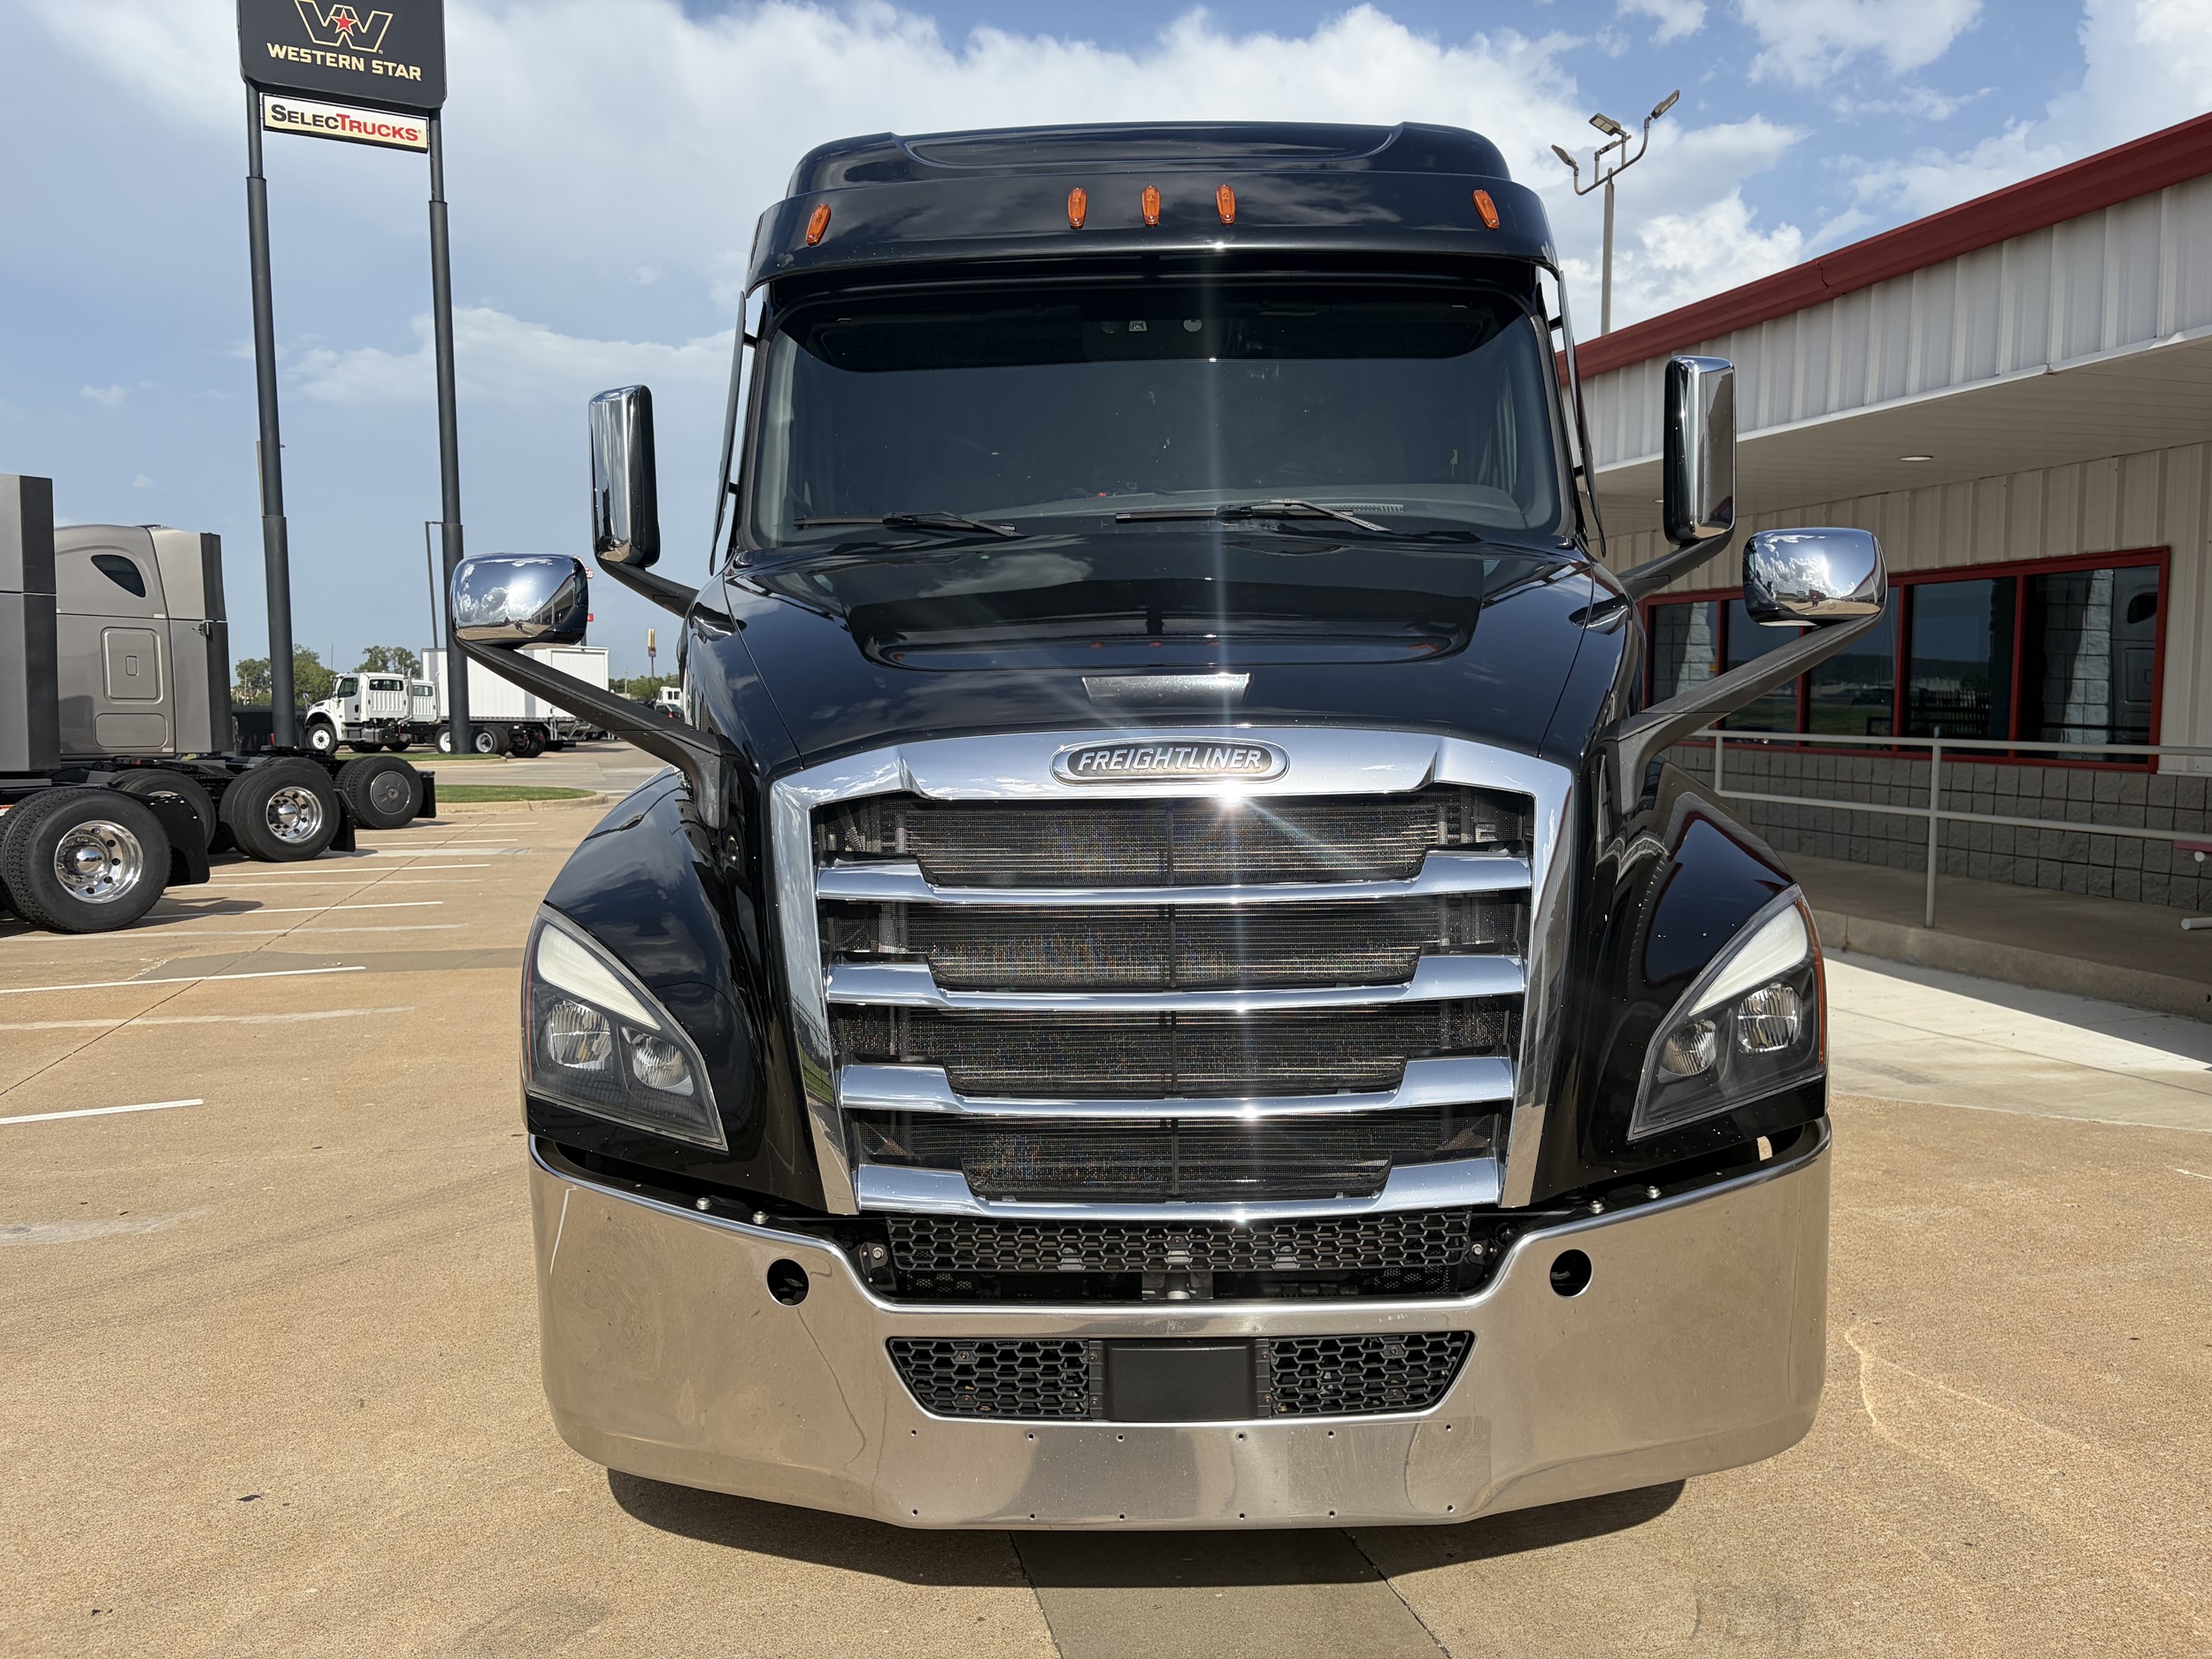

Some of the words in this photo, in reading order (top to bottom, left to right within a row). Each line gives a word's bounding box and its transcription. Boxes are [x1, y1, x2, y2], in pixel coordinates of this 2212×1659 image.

[266, 42, 365, 72] WESTERN
[372, 59, 422, 81] STAR
[1078, 747, 1262, 772] FREIGHTLINER
